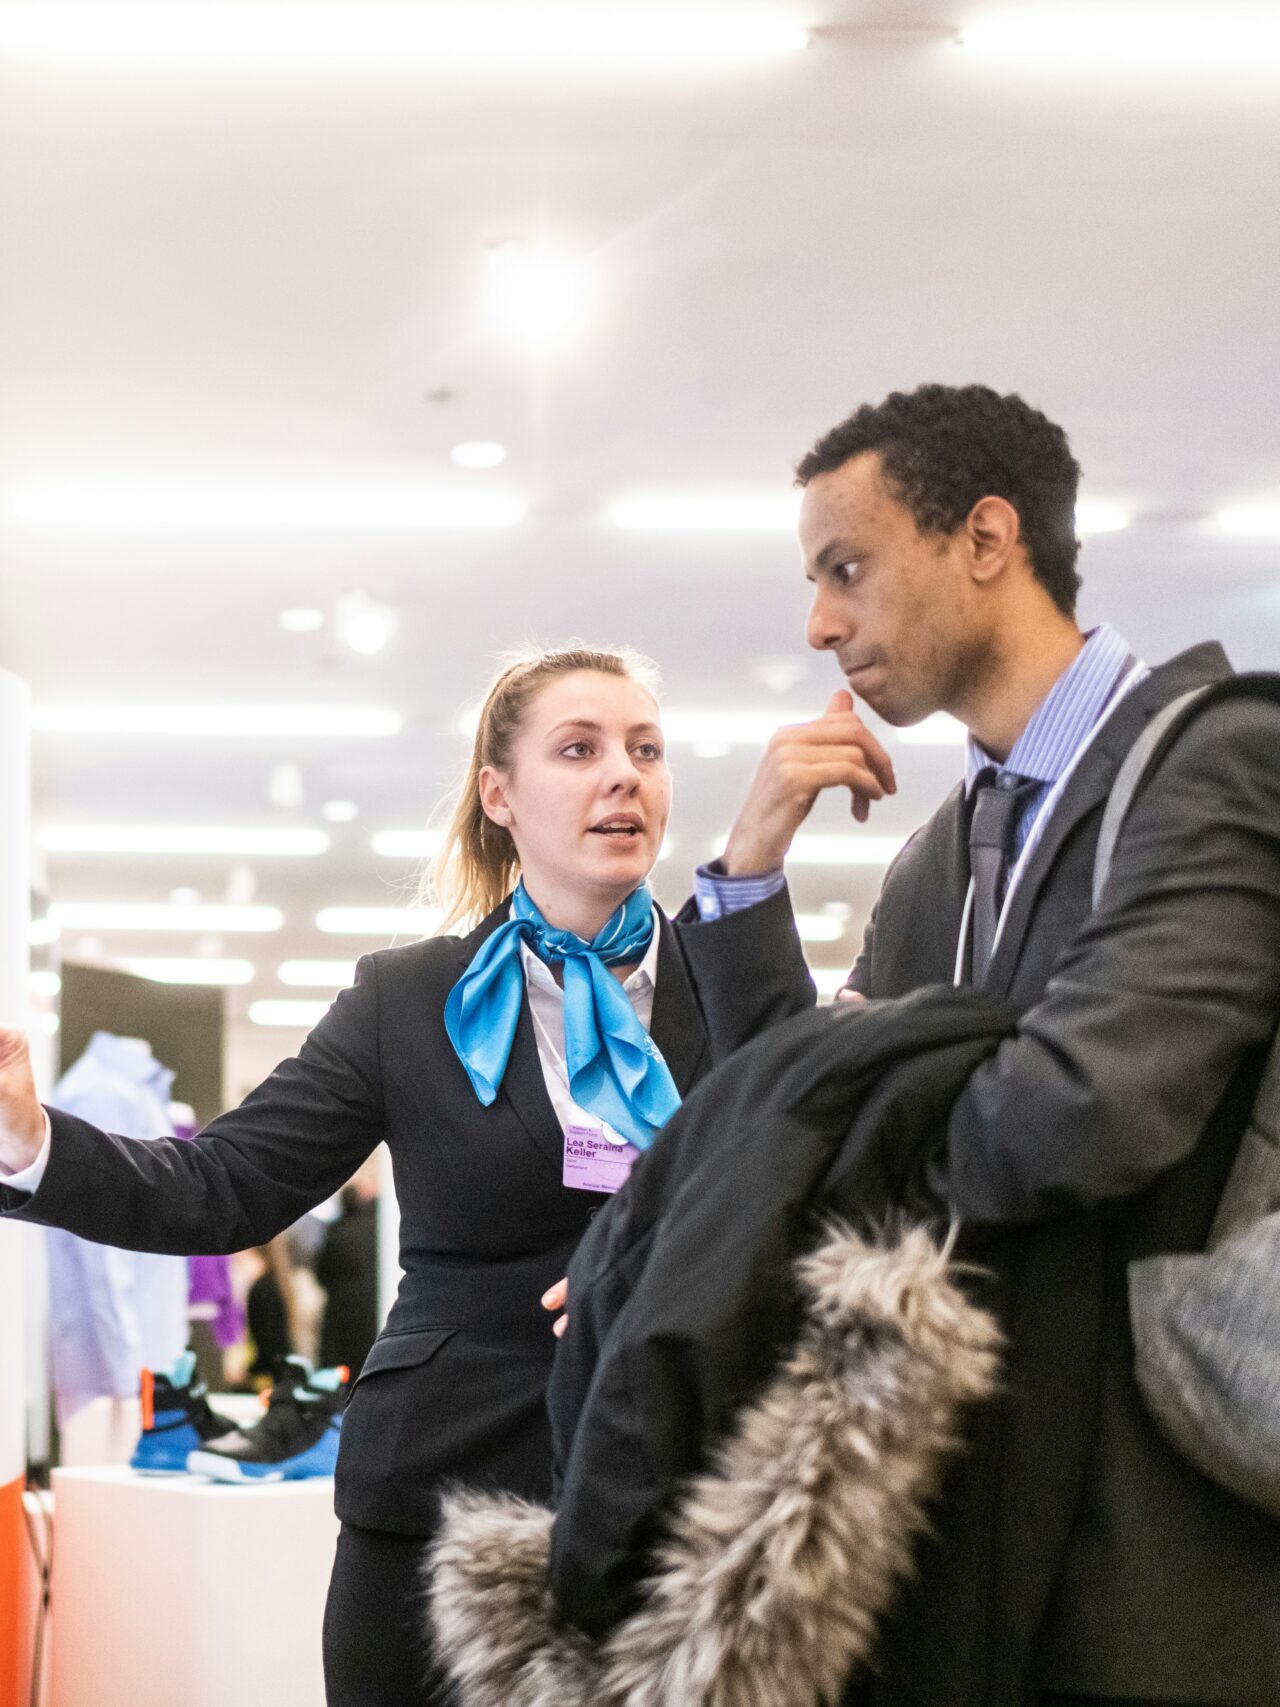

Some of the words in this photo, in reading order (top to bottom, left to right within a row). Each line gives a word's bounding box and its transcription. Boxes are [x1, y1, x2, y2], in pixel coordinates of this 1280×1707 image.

[567, 1137, 584, 1147] Lea
[587, 1140, 623, 1152] Seraina
[566, 1146, 596, 1158] Keller
